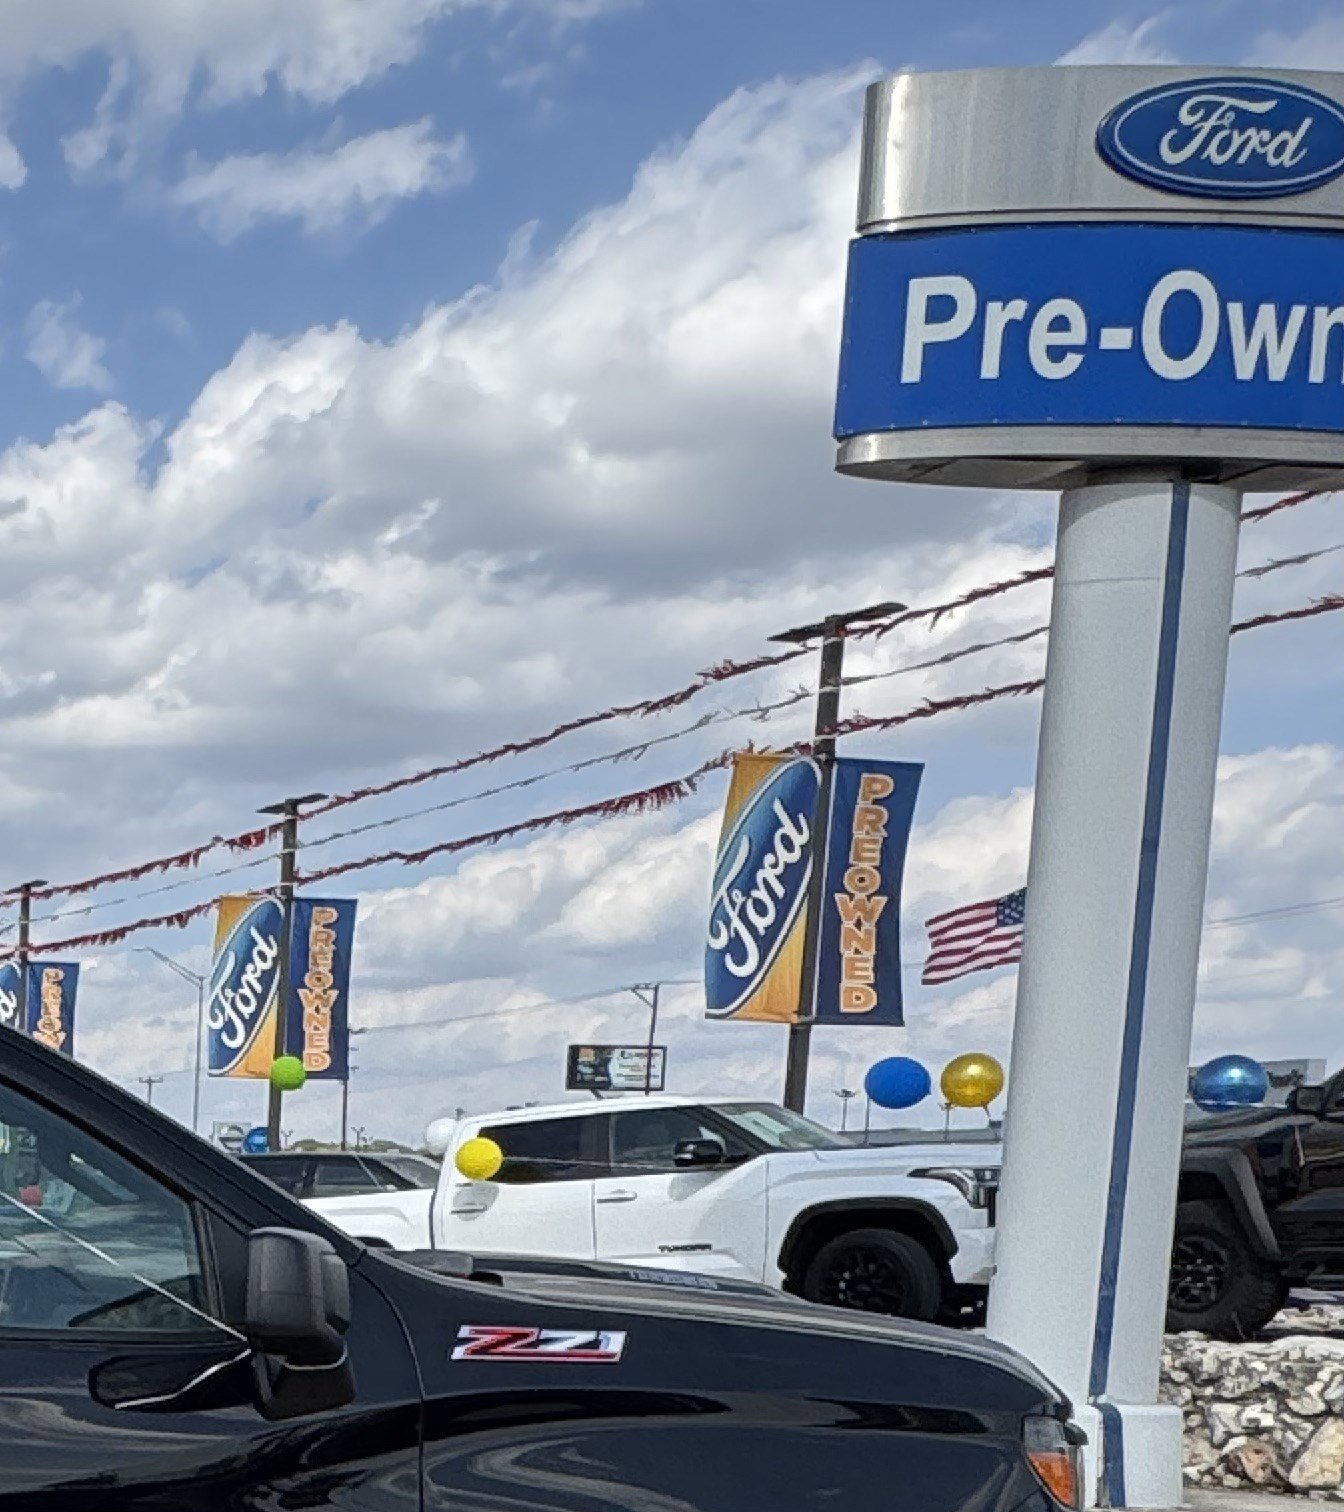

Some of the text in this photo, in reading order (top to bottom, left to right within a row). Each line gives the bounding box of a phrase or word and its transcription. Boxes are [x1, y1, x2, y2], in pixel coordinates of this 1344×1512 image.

[1159, 94, 1313, 168] Ford
[708, 798, 810, 979] Ford
[834, 772, 895, 1013] PREOWNED
[208, 926, 278, 1049] Ford
[450, 1324, 628, 1362] Z71
